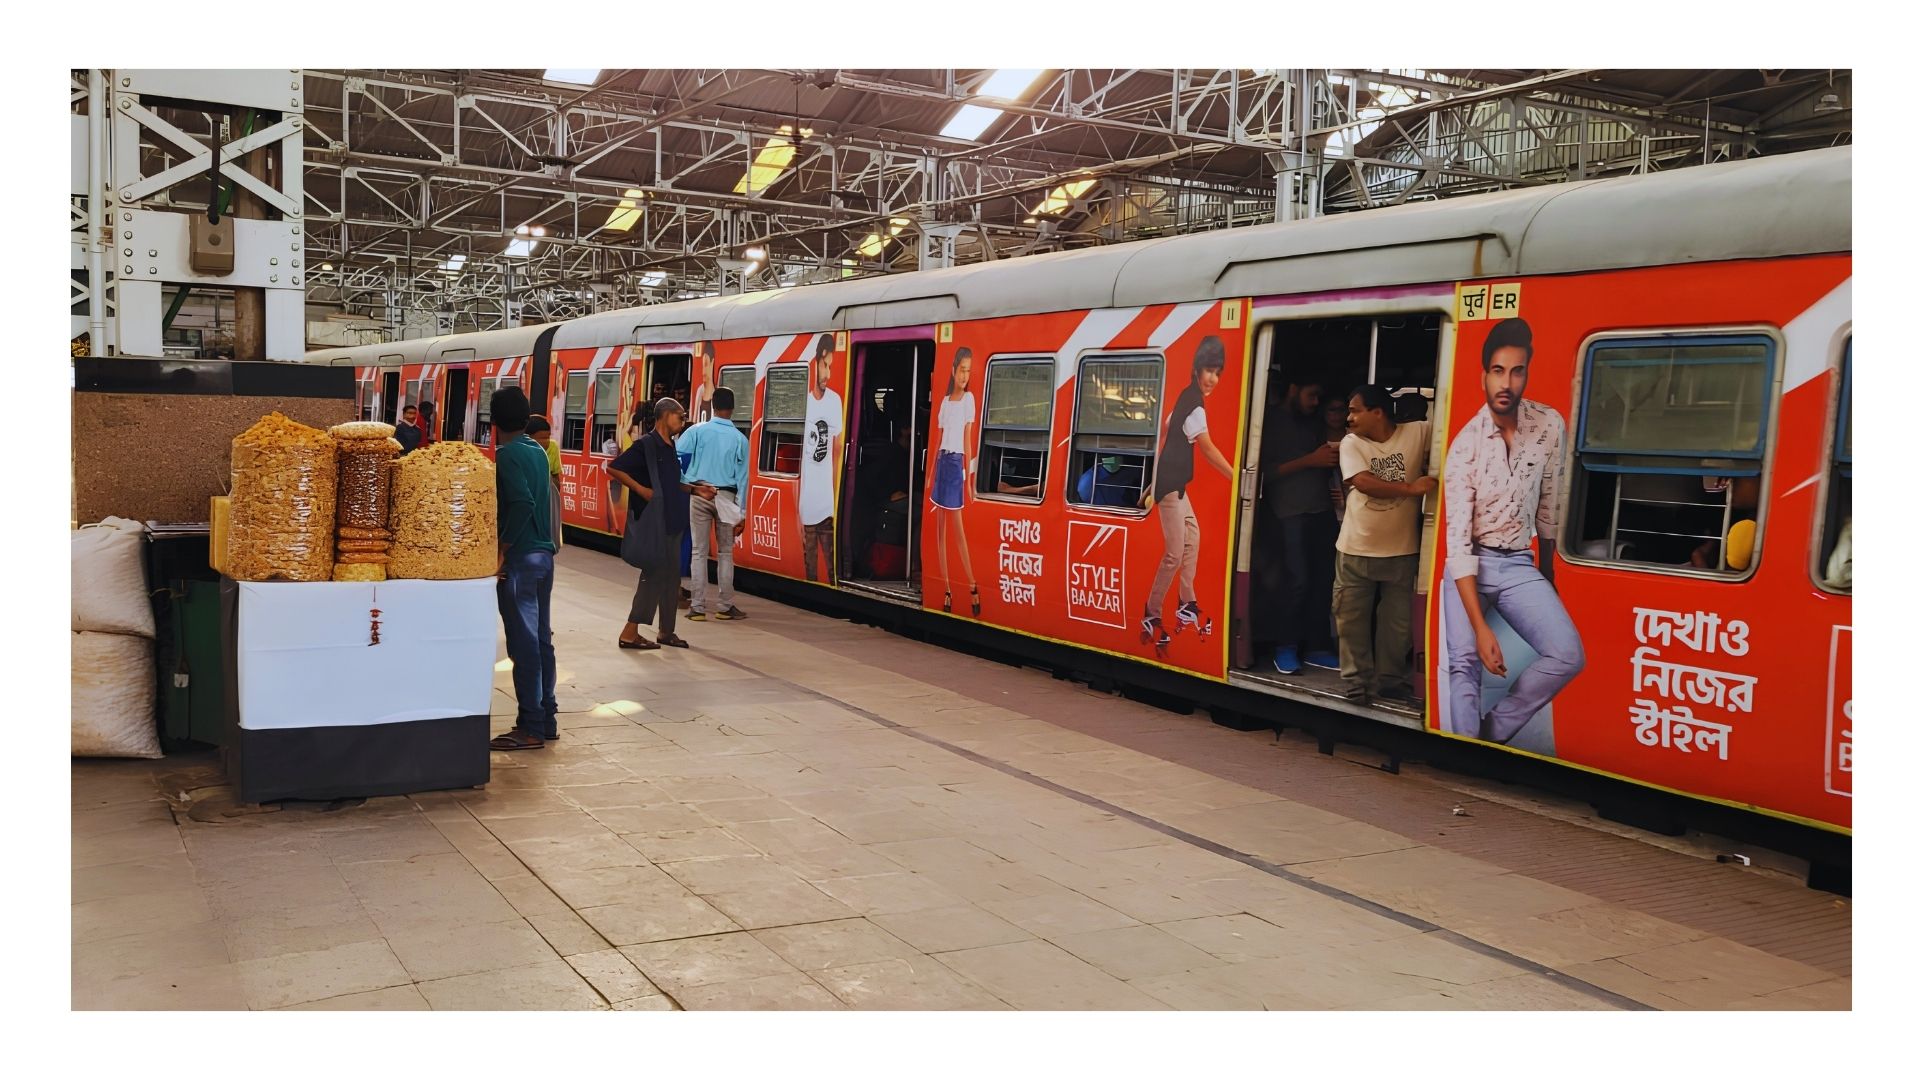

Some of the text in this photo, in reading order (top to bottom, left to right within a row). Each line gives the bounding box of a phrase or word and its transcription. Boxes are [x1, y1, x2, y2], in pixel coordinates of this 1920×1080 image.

[1463, 288, 1486, 317] पूर्व
[1493, 293, 1517, 310] ER
[999, 518, 1041, 544] দেখাও
[998, 543, 1043, 577] নিজের
[1071, 563, 1120, 593] STYLE
[1071, 588, 1121, 613] BAAZAR
[1632, 607, 1750, 657] দেখাও
[1630, 646, 1759, 713] নিজের
[1628, 698, 1733, 761] স্টাইল
